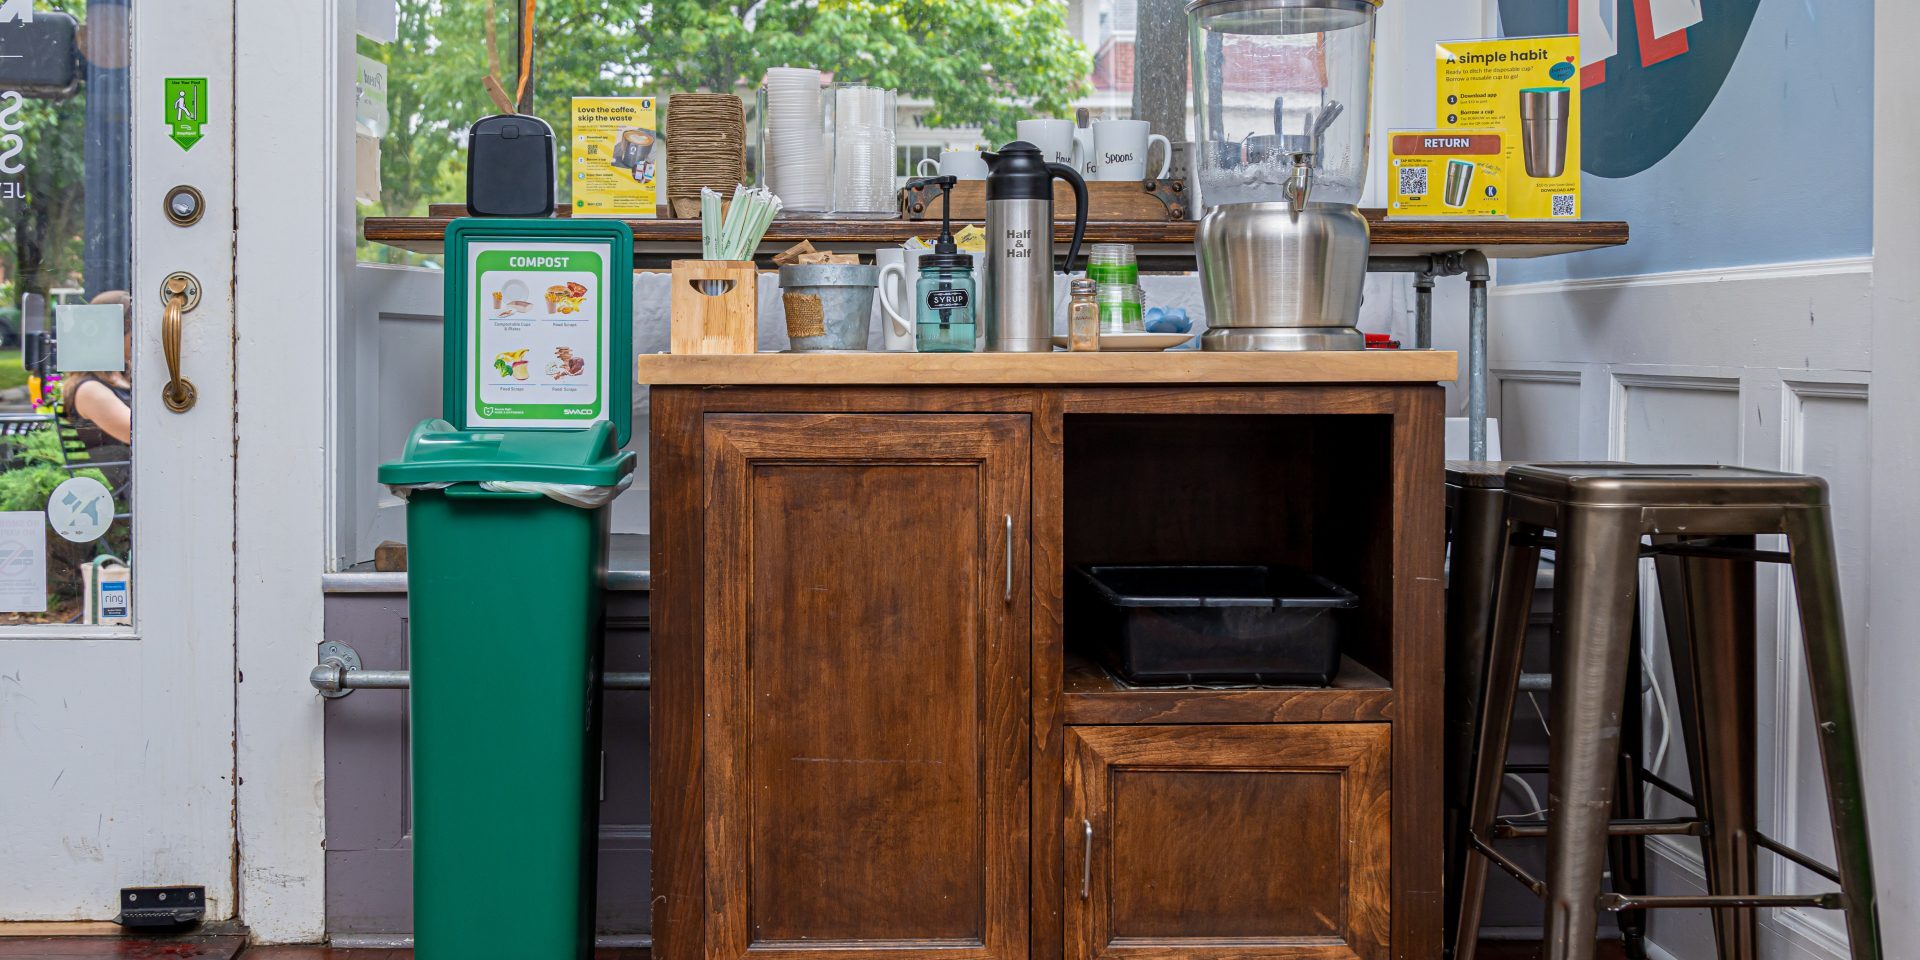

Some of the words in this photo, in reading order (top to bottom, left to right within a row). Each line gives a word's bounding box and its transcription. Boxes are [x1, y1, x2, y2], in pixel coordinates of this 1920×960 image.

[1446, 54, 1455, 64] A
[1459, 52, 1506, 66] simple
[1510, 49, 1548, 61] habit
[1424, 138, 1470, 148] RETURN
[1105, 152, 1133, 164] Spoons
[1007, 230, 1032, 239] Half
[1015, 239, 1024, 248] &
[1007, 248, 1032, 258] Half
[510, 257, 569, 268] COMPOST
[105, 594, 123, 604] ring
